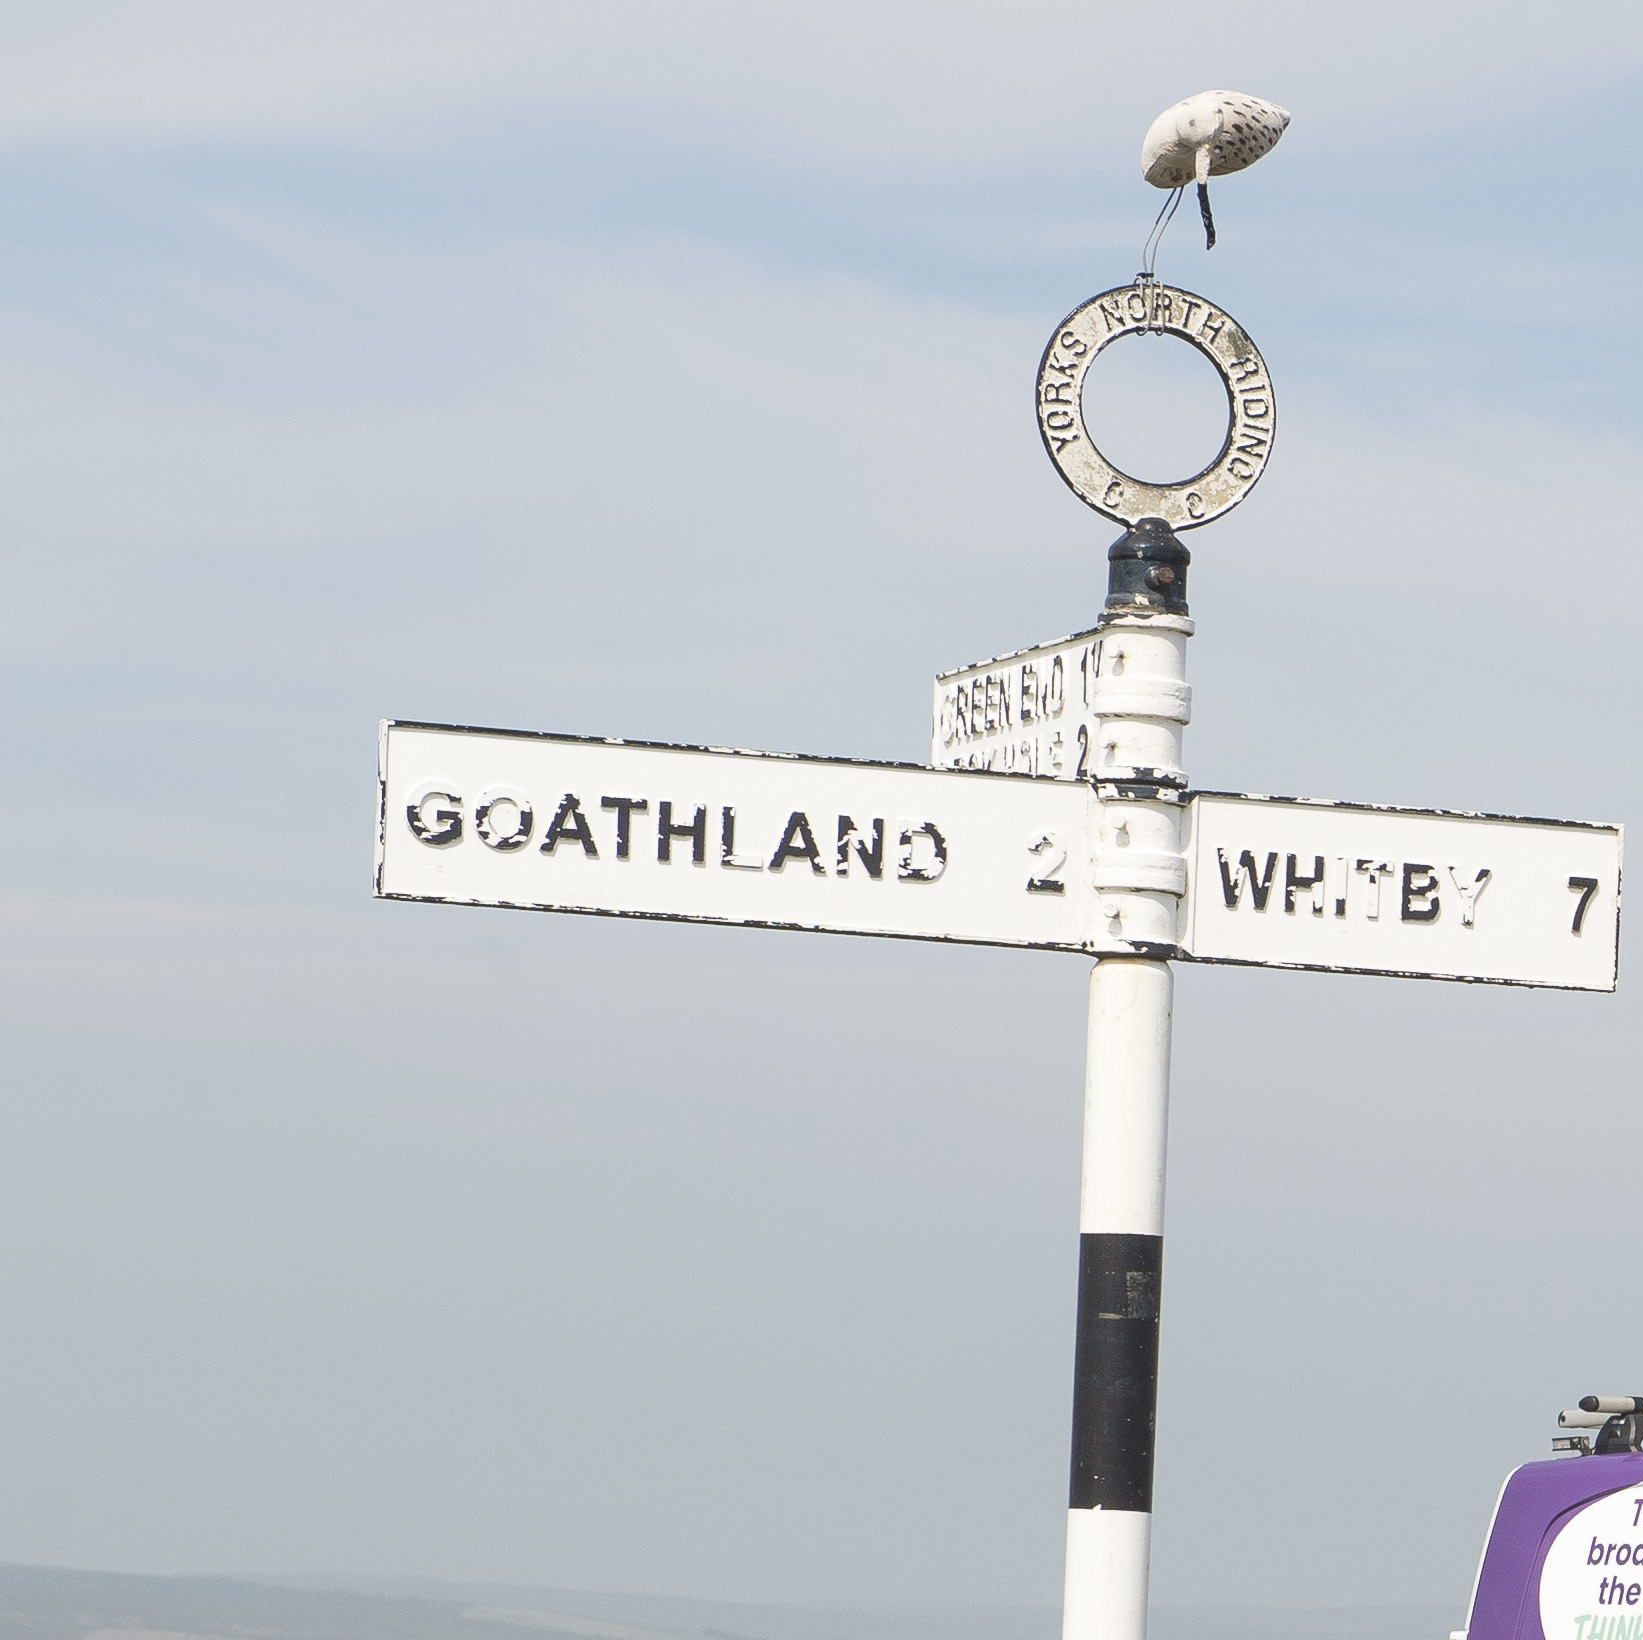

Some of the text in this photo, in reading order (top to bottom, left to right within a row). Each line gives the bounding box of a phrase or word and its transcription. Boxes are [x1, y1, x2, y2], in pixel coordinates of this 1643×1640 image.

[1043, 292, 1270, 481] YORKS NORTH RIDING
[940, 673, 1012, 747] GREEN
[1020, 654, 1065, 725] END
[405, 781, 1067, 896] GOATHLAND 2
[1217, 847, 1599, 937] WHITBY 7
[1598, 1576, 1641, 1606] the
